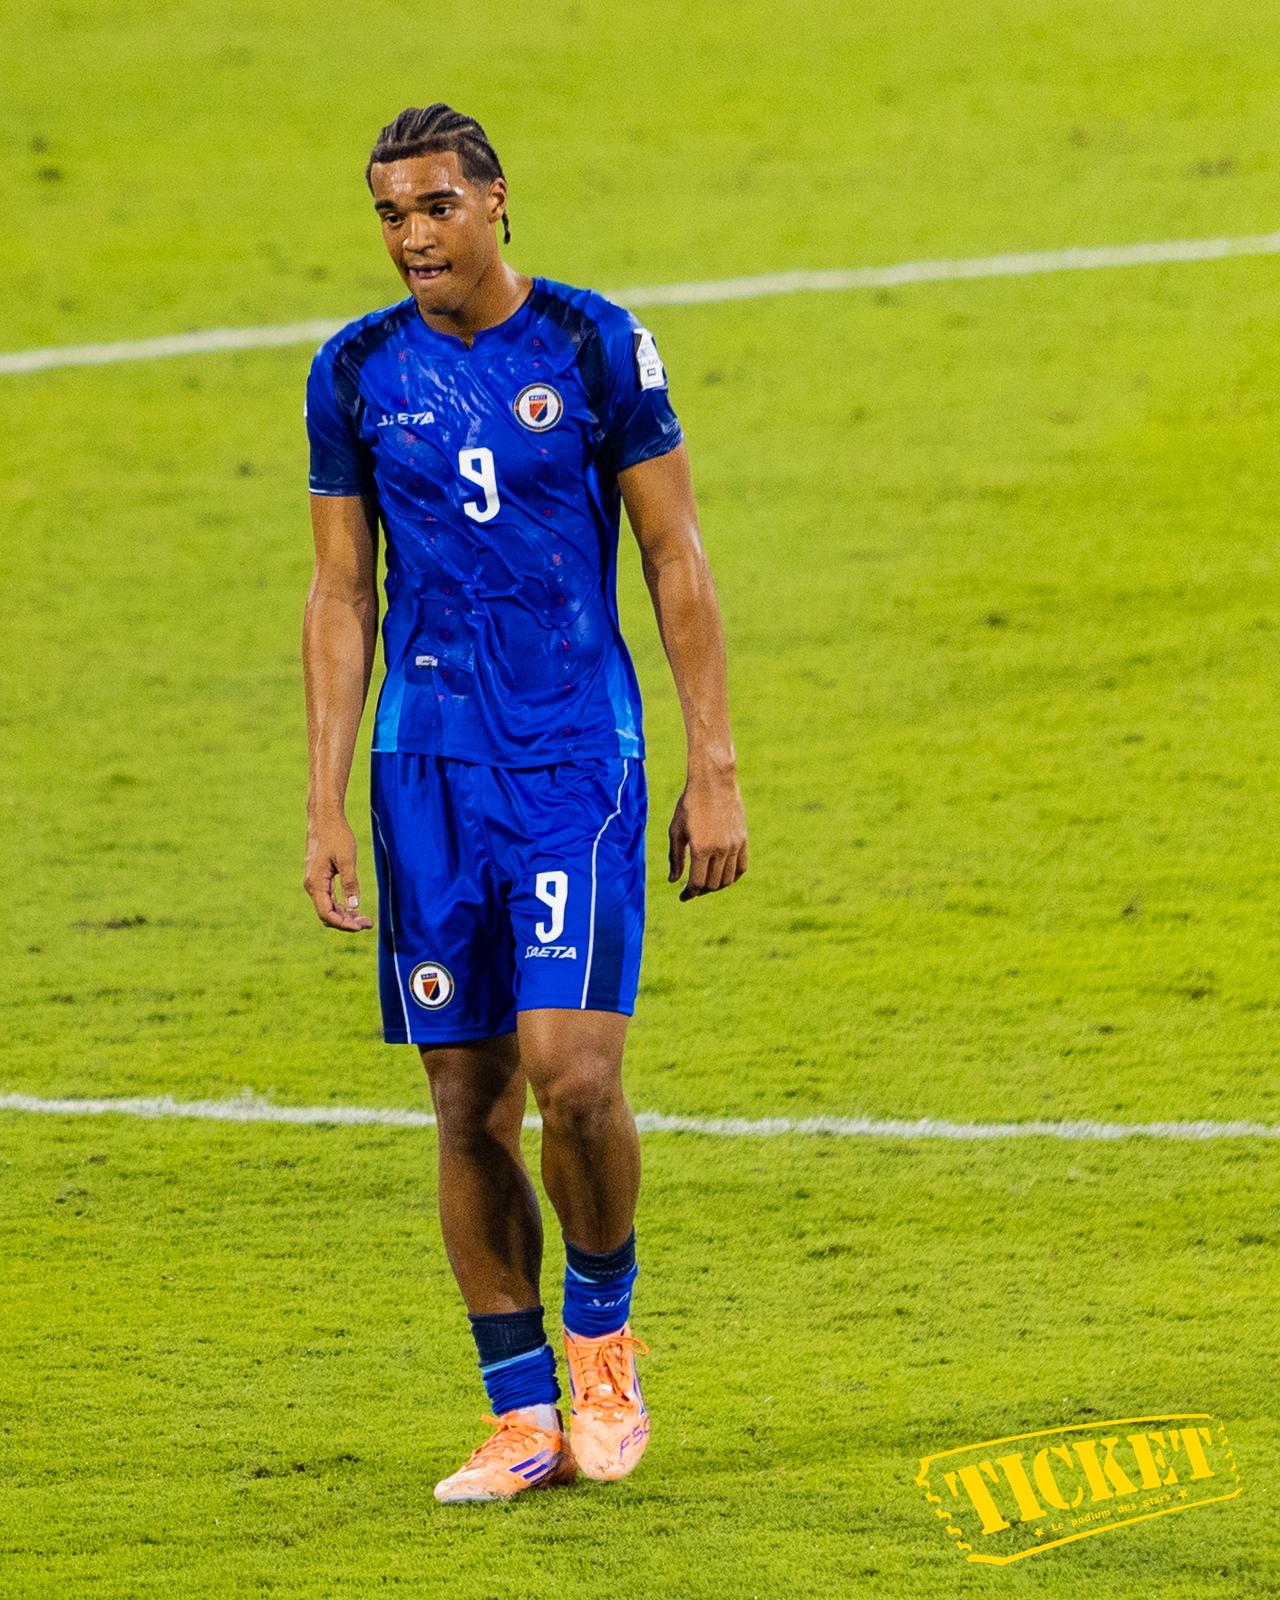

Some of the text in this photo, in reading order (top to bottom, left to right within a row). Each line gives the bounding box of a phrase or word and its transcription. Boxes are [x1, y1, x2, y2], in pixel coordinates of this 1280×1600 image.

[458, 447, 501, 523] 9
[535, 870, 569, 944] 9
[524, 945, 577, 960] SAETA
